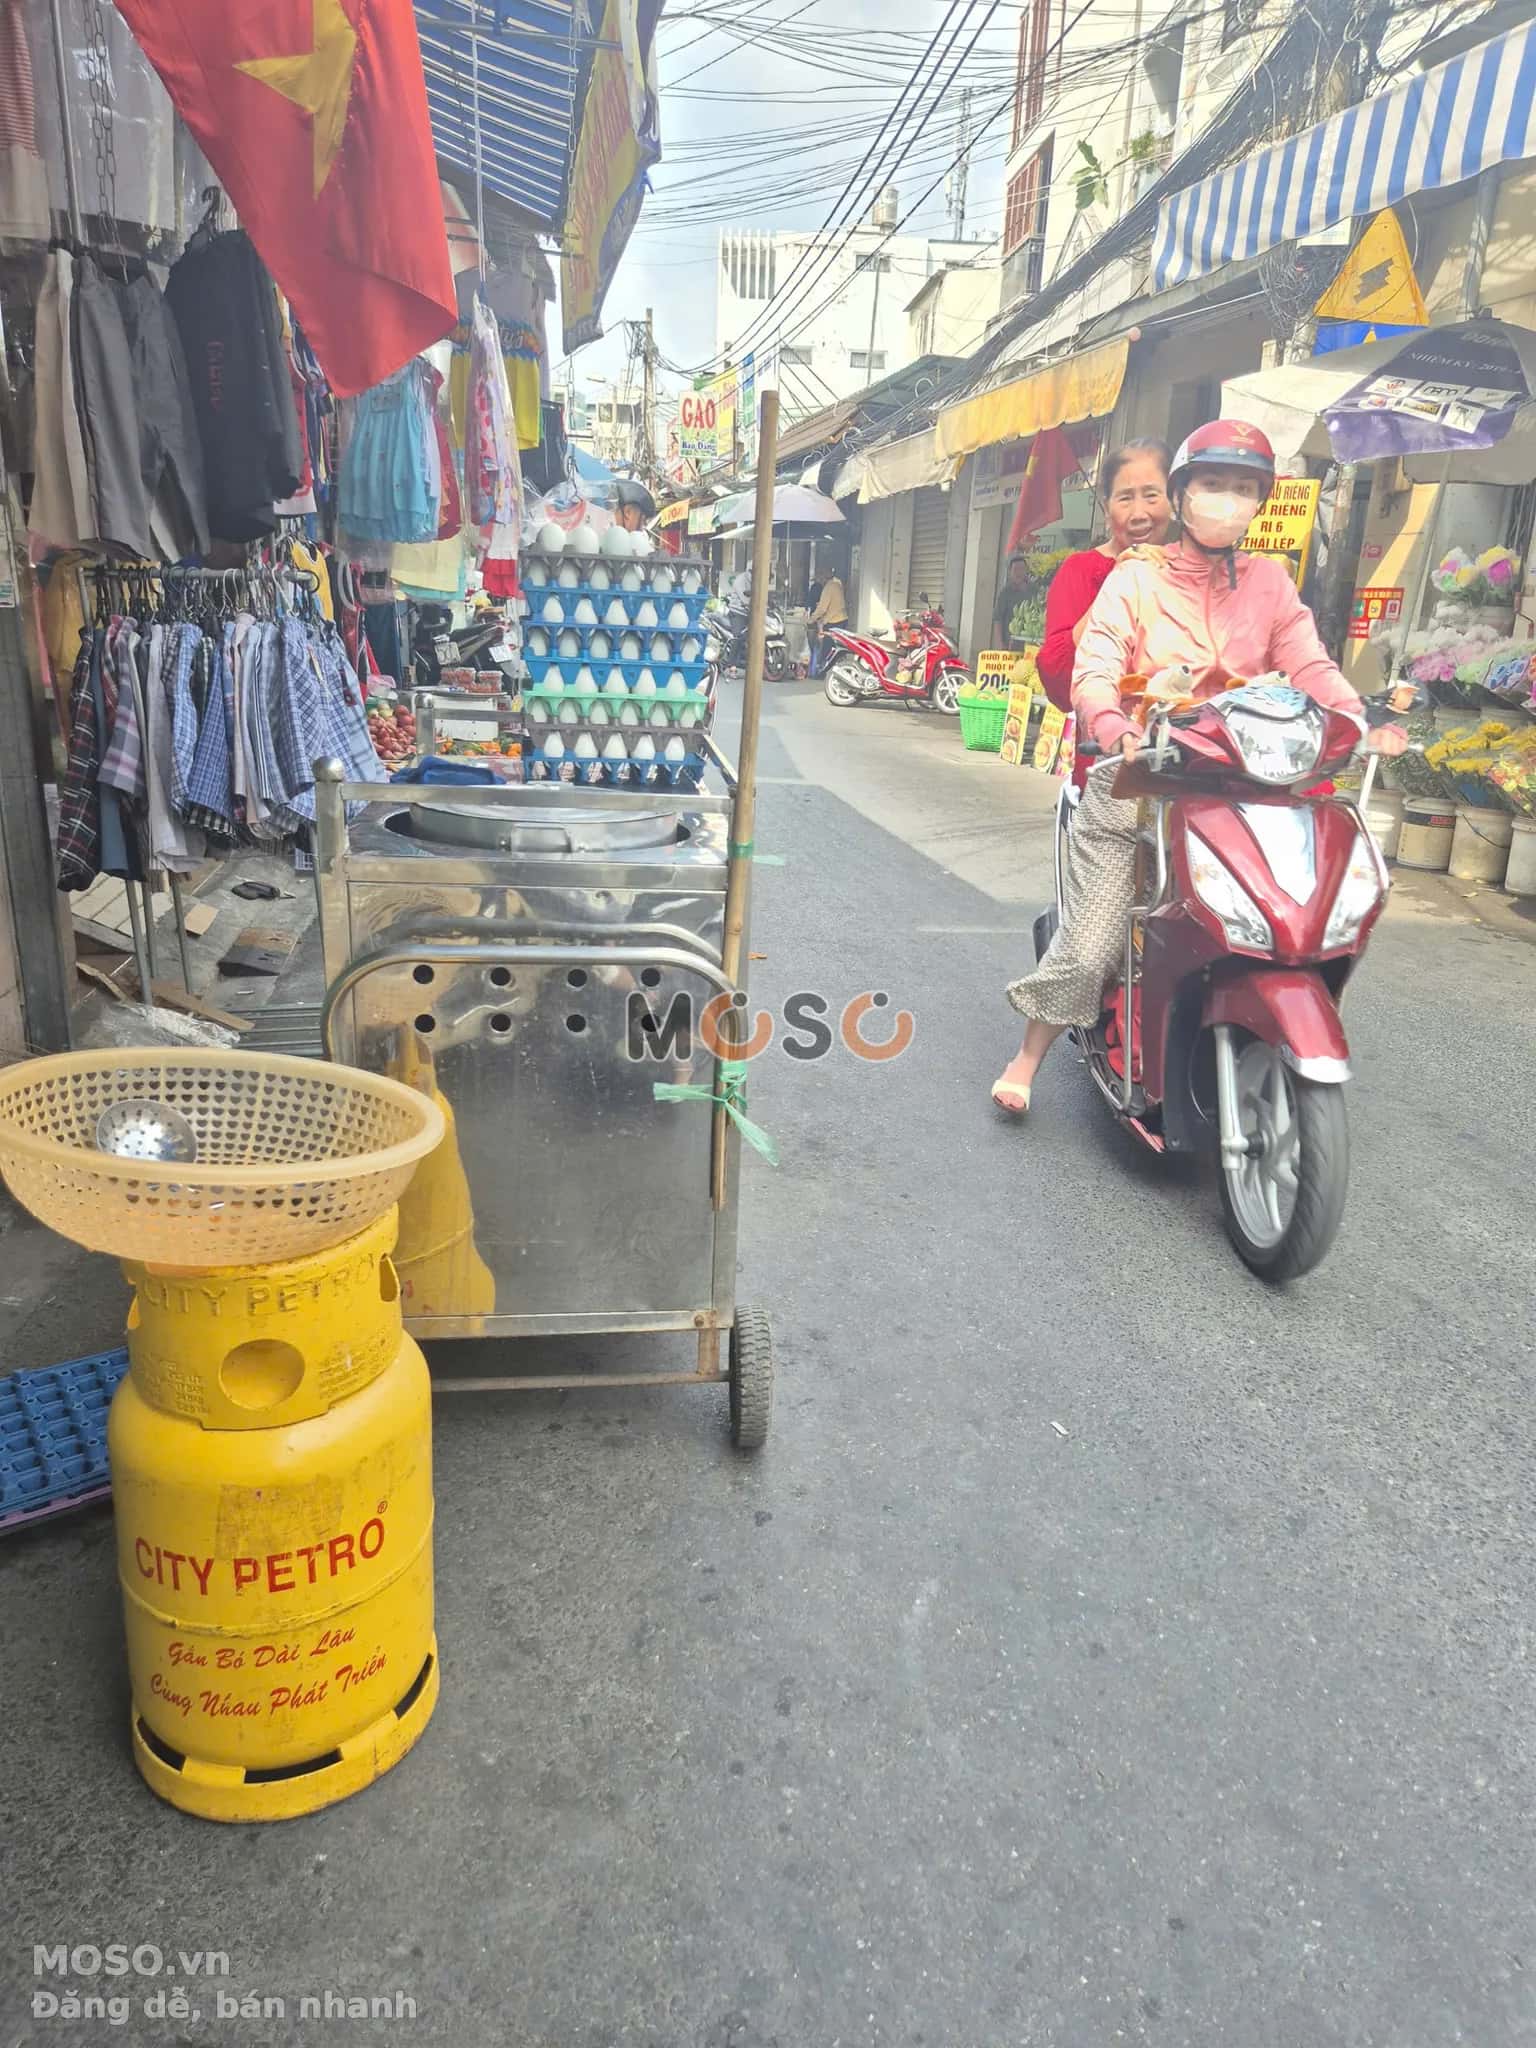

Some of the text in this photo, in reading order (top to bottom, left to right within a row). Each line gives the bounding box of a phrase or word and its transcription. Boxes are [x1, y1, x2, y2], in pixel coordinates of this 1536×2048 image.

[1260, 521, 1284, 533] RI 6
[1270, 502, 1307, 516] RIÊNG
[135, 1517, 386, 1597] CITY PETRO
[254, 1644, 301, 1668] Dài
[310, 1627, 356, 1657] Lâu
[150, 1673, 193, 1717] Cùng
[200, 1690, 262, 1717] Nhau
[269, 1680, 329, 1716] Phát
